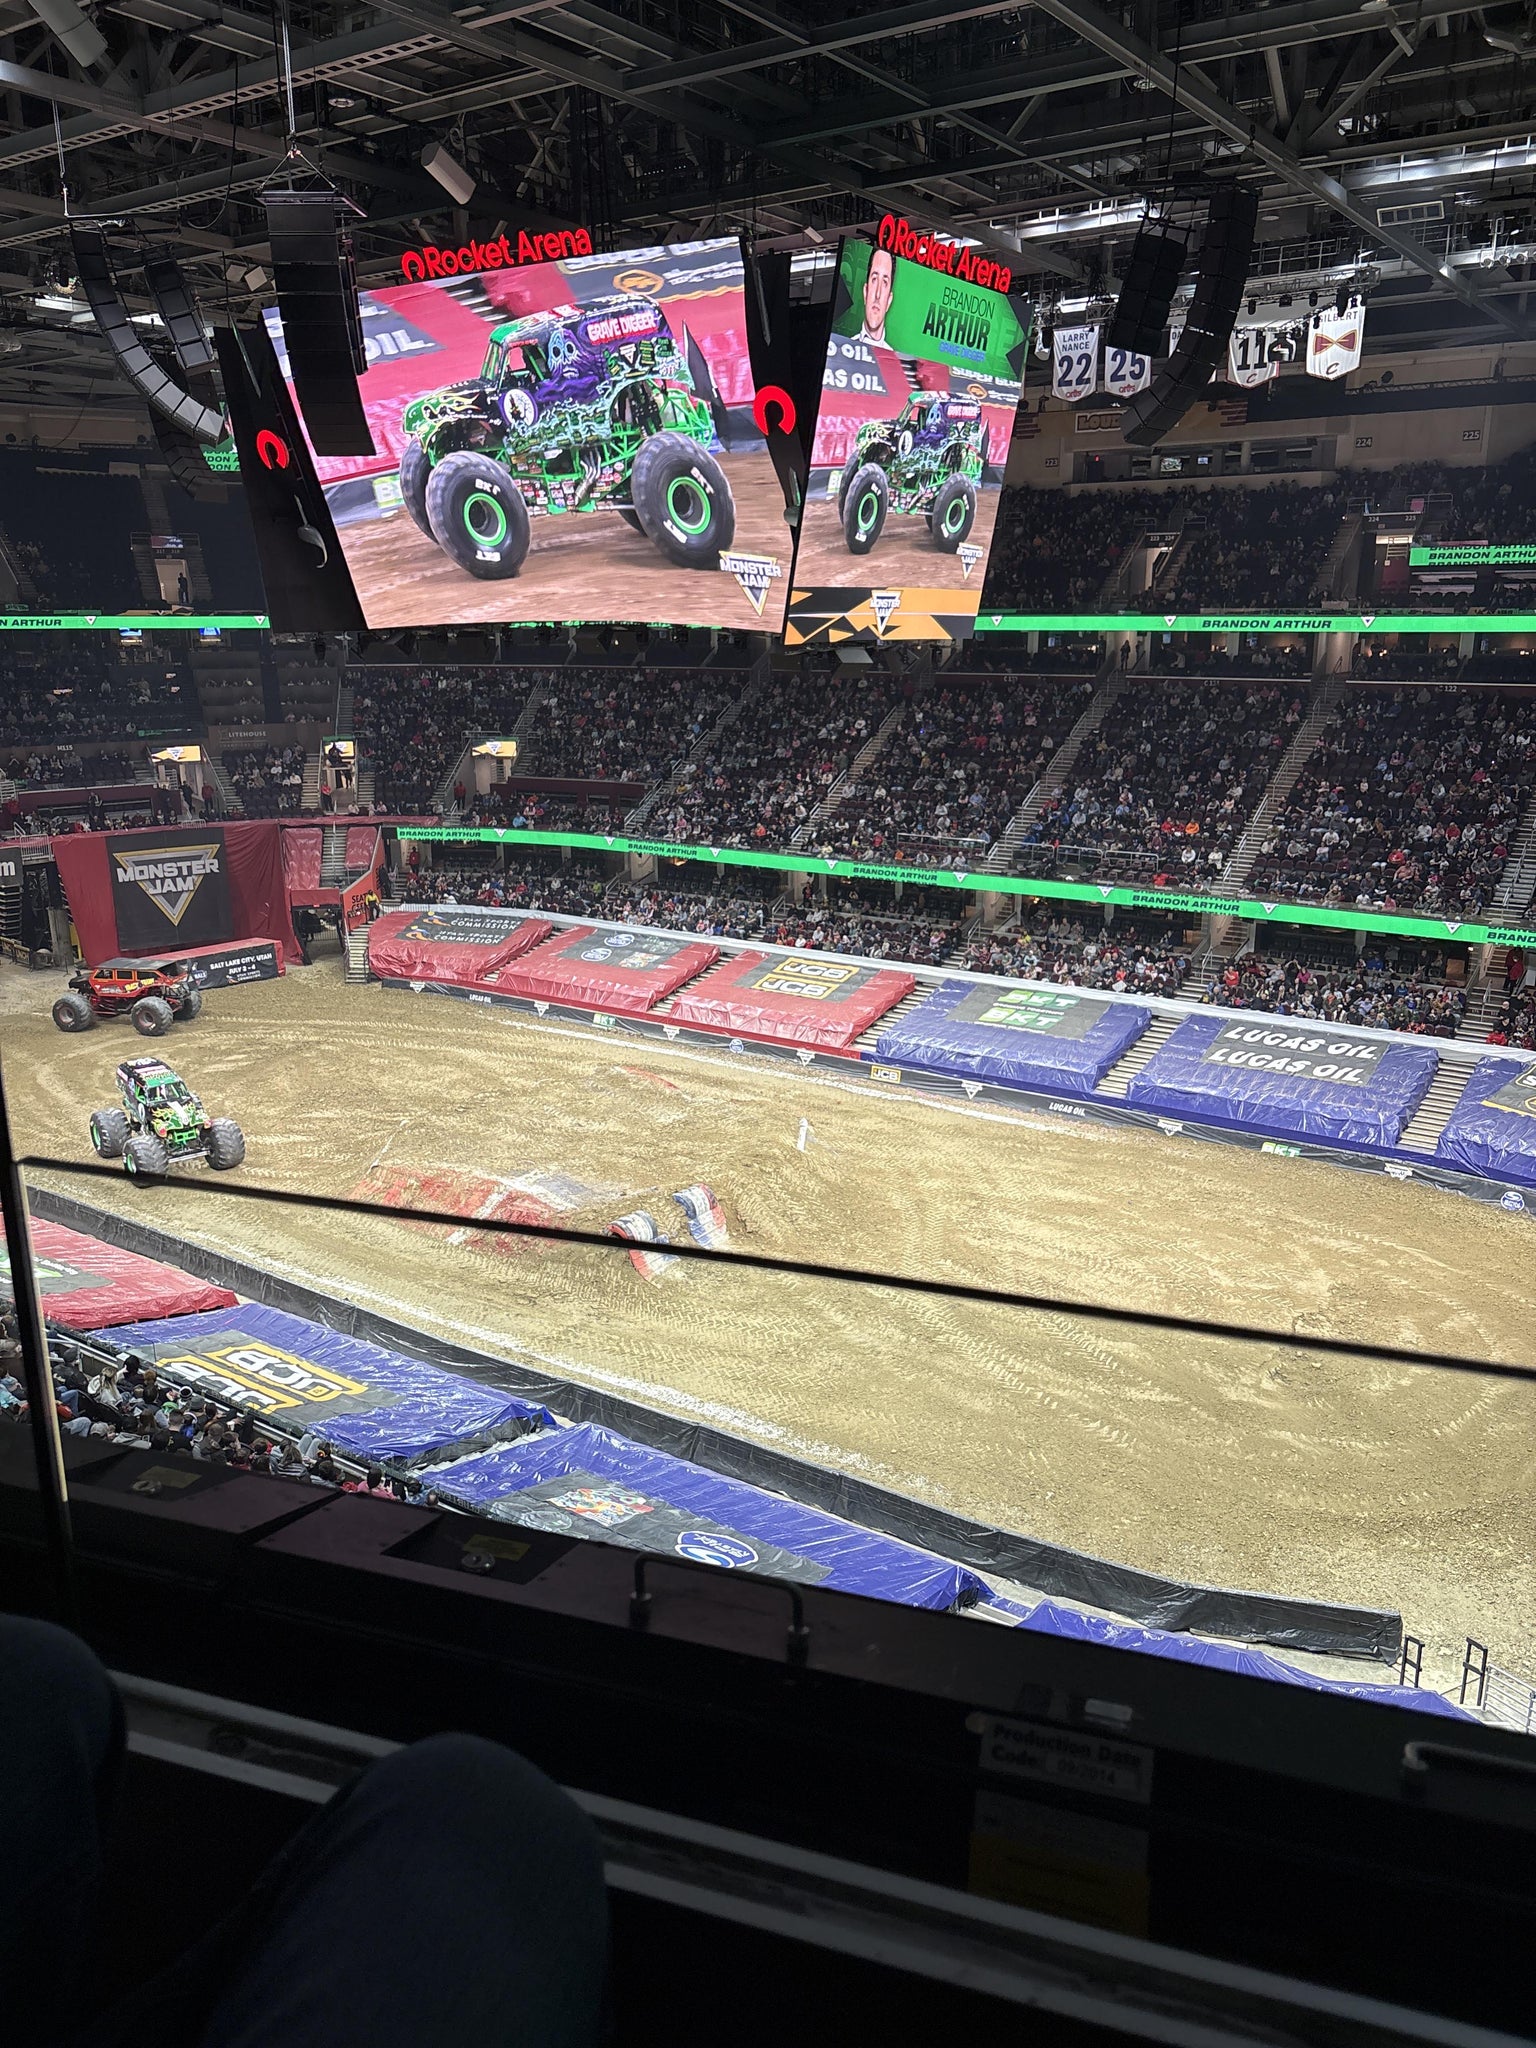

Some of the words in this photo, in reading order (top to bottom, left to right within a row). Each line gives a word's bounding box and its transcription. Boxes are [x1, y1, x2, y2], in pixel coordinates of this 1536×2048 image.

[422, 234, 514, 278] Rocket
[518, 228, 593, 263] Arena
[894, 219, 958, 273] Rocket
[955, 246, 1012, 293] Arena
[941, 286, 996, 320] BRANDON
[587, 318, 621, 342] GRAVE
[620, 312, 657, 336] DIGGER
[922, 302, 991, 351] ARTHUR
[1062, 331, 1090, 343] LARRY
[1061, 341, 1090, 352] NANCE
[1237, 331, 1267, 371] 11
[1058, 352, 1092, 387] 22
[1110, 349, 1146, 382] 25
[1356, 438, 1372, 447] 224
[1463, 431, 1480, 440] 225
[1428, 551, 1492, 560] BRANDON
[719, 558, 782, 578] MONSTER
[737, 574, 770, 590] JAM
[869, 599, 901, 609] MONSTER
[1202, 619, 1270, 629] BRANDON
[1273, 620, 1332, 629] ARTHUR
[228, 730, 267, 738] LITEHOUSE
[399, 830, 444, 838] BRANDON
[628, 843, 665, 853] BRANDON
[666, 848, 698, 856] ARTHUR
[116, 858, 220, 883] MONSTER
[853, 867, 898, 878] BRANDON
[900, 871, 938, 882] ARTHUR
[149, 876, 194, 895] JAM
[1132, 894, 1190, 908] BRANDON
[1191, 900, 1240, 912] ARTHUR
[450, 920, 518, 931] COMMISSION
[434, 934, 500, 944] COMMISSION
[209, 961, 225, 970] SALT
[225, 958, 240, 967] LAKE
[240, 956, 256, 964] CITY,
[256, 953, 272, 962] UTAH
[228, 967, 242, 975] JULY
[783, 962, 849, 979] JCB
[761, 978, 828, 996] JCB
[1003, 991, 1079, 1009] BKT
[984, 1009, 1060, 1028] BKT
[1223, 1026, 1323, 1052] LUCAS
[1208, 1048, 1312, 1074] LUCAS
[872, 1069, 898, 1081] JCB
[1049, 1101, 1073, 1114] LUCAS
[1262, 1142, 1301, 1157] BKT
[992, 1722, 1092, 1758] Production
